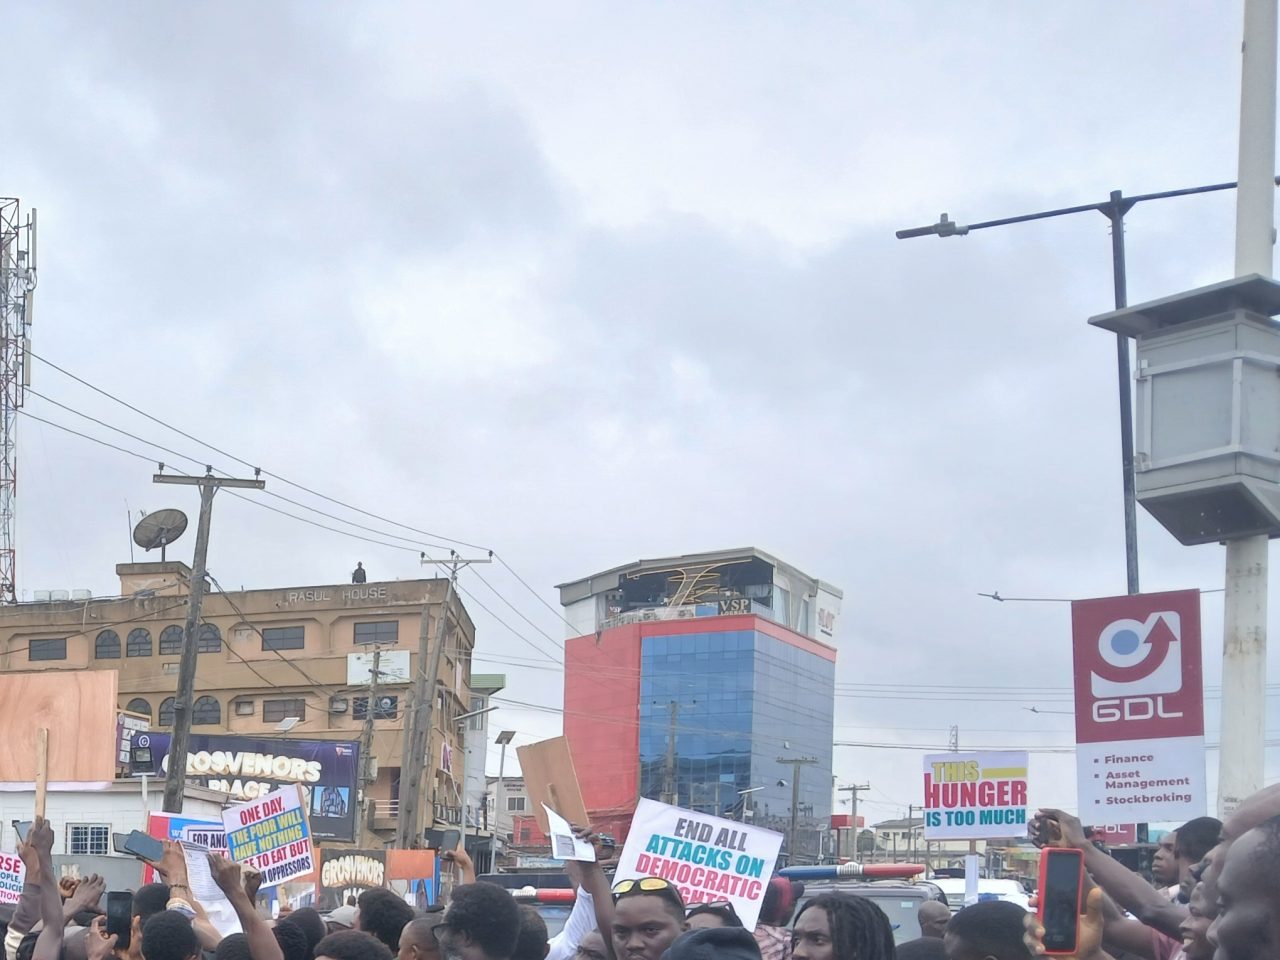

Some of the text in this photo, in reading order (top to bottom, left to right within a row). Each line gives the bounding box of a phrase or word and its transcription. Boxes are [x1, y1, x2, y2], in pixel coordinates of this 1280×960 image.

[290, 587, 387, 603] RASUL HOUSE
[720, 599, 749, 611] VSP
[1092, 696, 1183, 723] GDL
[931, 760, 979, 782] THIS
[1104, 753, 1154, 764] Finance
[1106, 770, 1140, 779] Asset
[1106, 777, 1190, 790] Management
[924, 772, 1027, 808] HUNGER
[1106, 792, 1192, 806] Stockbroking
[240, 796, 285, 826] ONE DAY,
[926, 809, 1026, 827] IS TOO MUCH
[210, 833, 227, 848] ANO
[230, 810, 303, 845] THE POOR WILL
[674, 818, 747, 852] END ALL
[234, 826, 303, 861] HAVE NOTHING
[256, 854, 269, 868] TO
[271, 846, 286, 864] EAT
[290, 839, 308, 858] BUT
[645, 834, 765, 878] ATTACKS ON
[268, 856, 310, 882] OPPRESSORS
[322, 855, 384, 887] GROSVENORS
[635, 854, 762, 901] DEMOCRATIC
